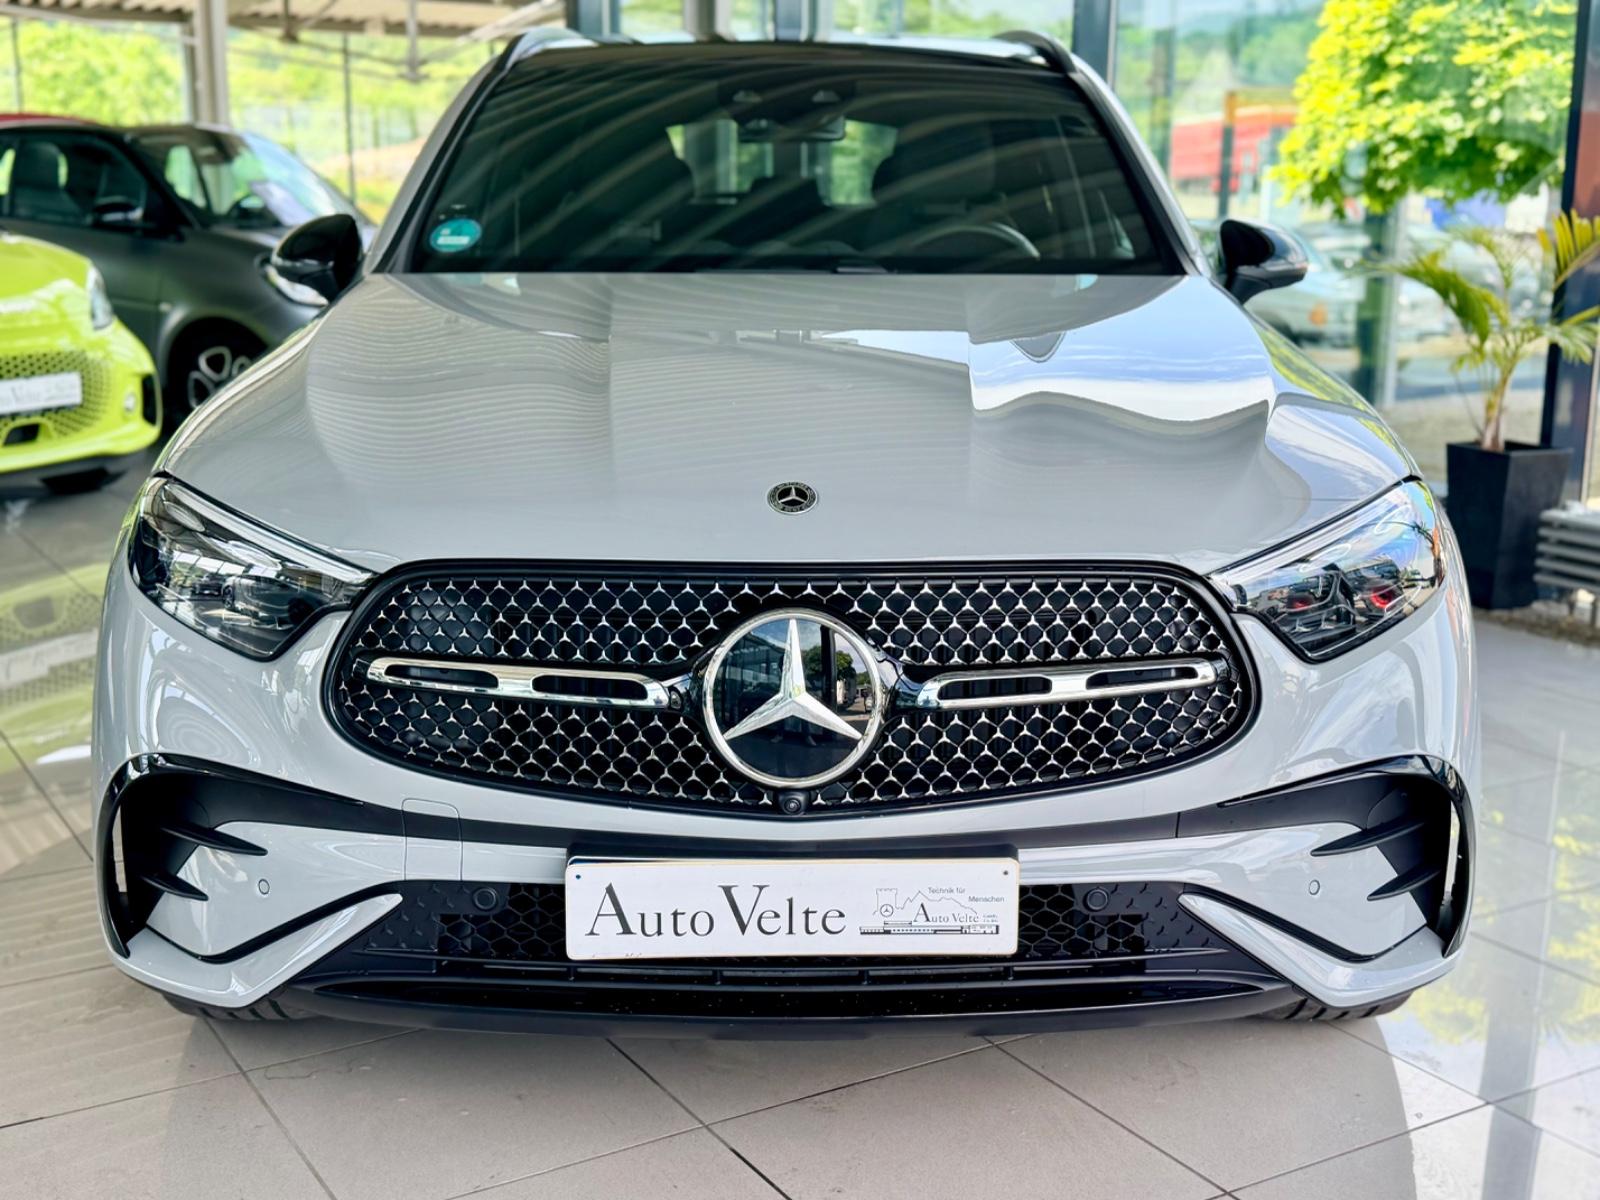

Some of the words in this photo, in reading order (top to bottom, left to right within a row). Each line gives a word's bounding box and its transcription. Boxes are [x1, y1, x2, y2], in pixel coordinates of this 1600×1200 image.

[928, 886, 955, 894] Technik
[956, 886, 966, 894] für
[968, 895, 1005, 903] Menschen
[585, 882, 714, 937] Auto
[717, 884, 847, 936] Velte
[913, 902, 949, 923] Auto
[952, 912, 979, 923] Velte
